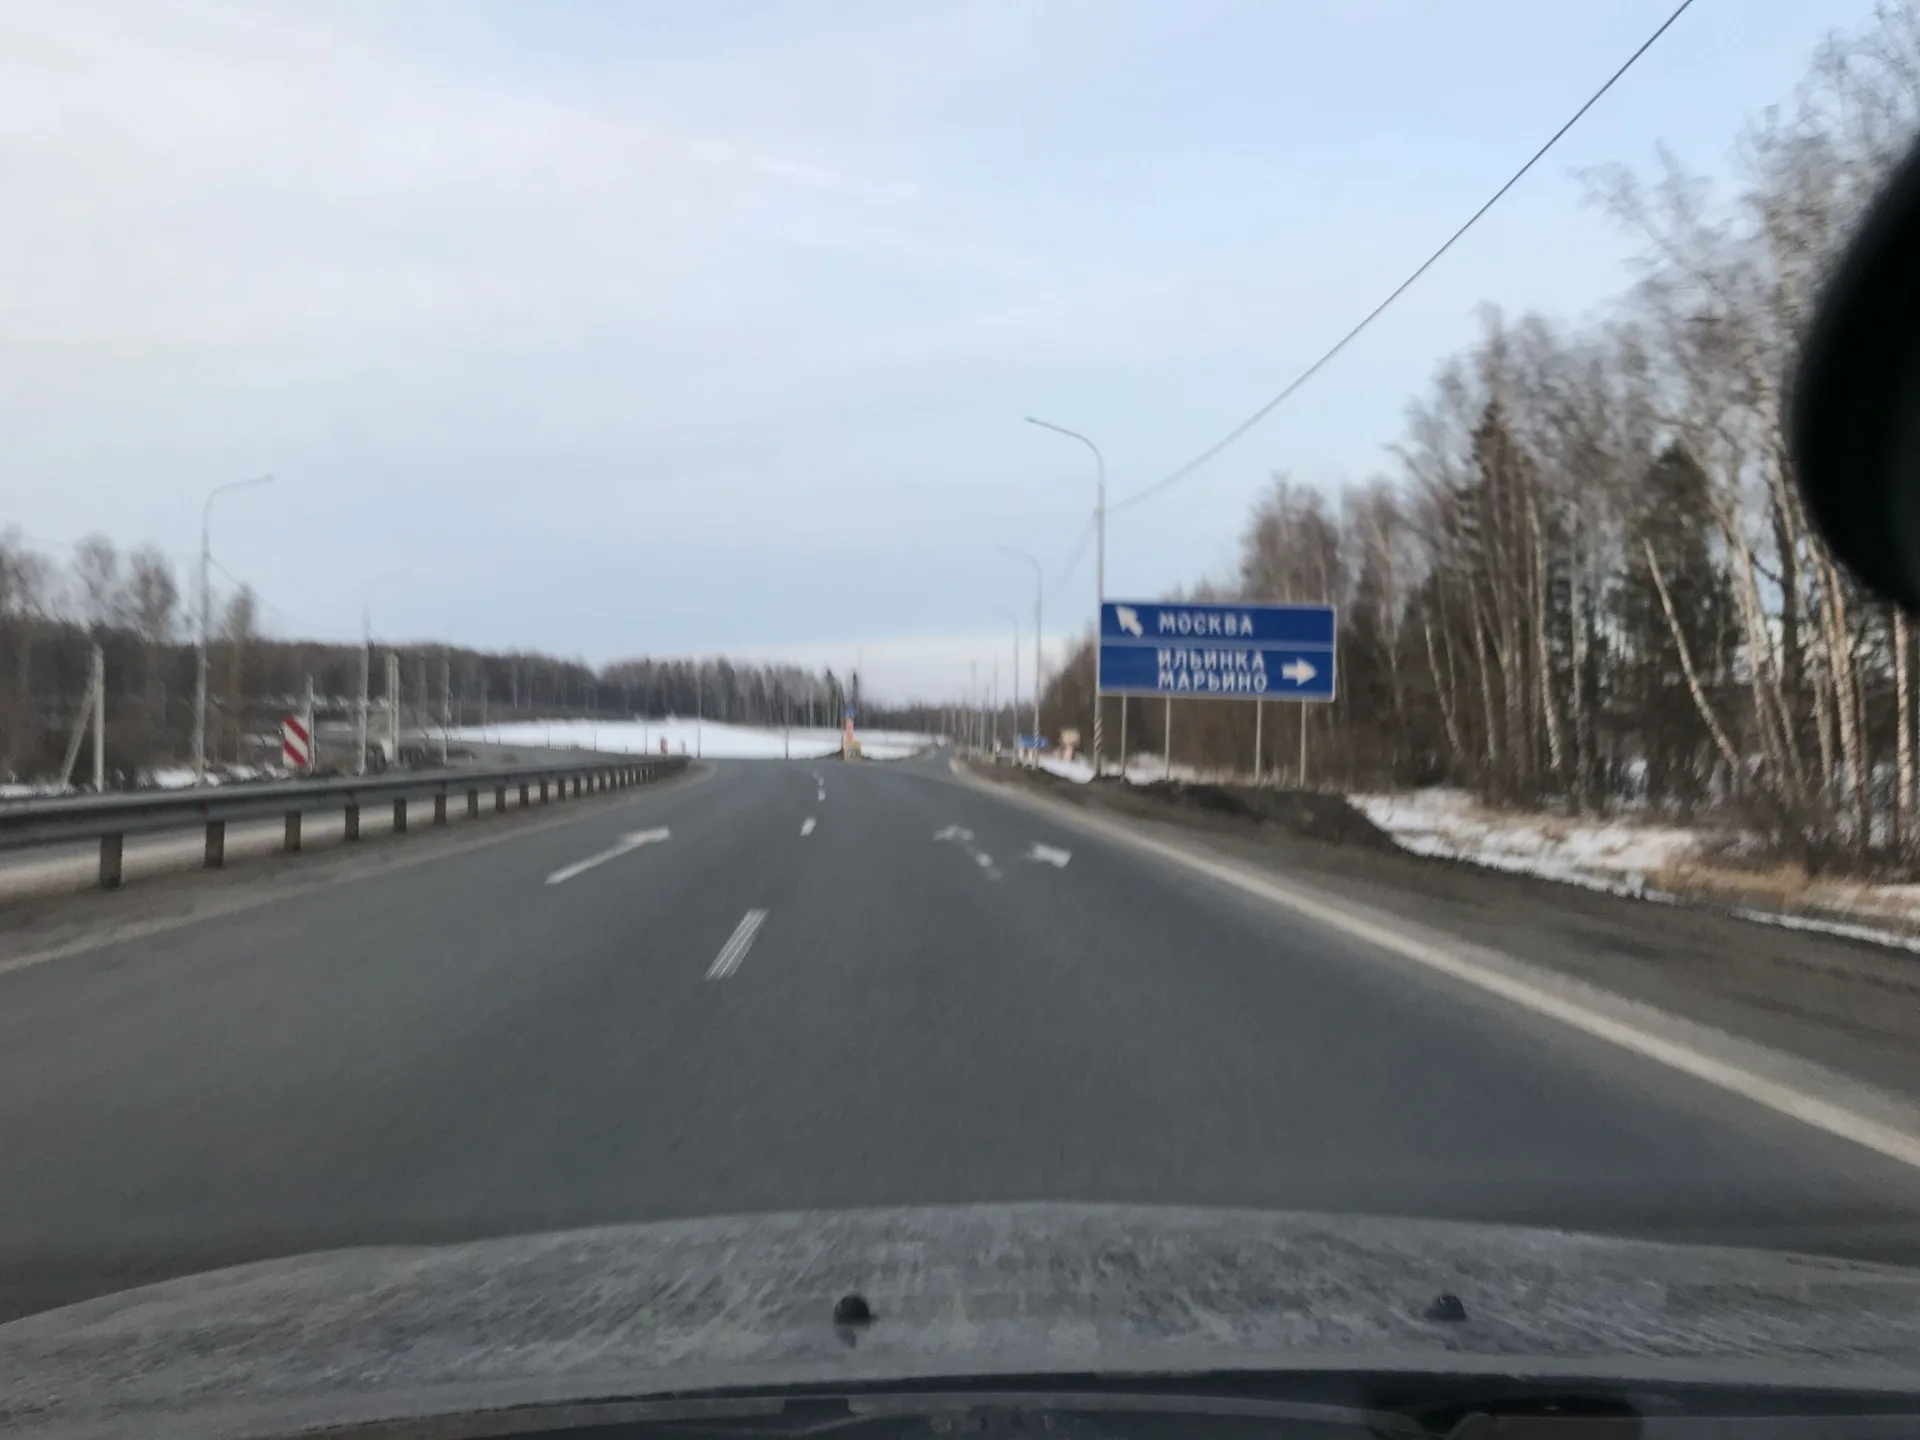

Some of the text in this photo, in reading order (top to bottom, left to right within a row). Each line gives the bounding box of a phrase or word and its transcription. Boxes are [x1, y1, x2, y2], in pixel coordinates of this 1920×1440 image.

[1158, 611, 1253, 636] МОСКВА
[1157, 649, 1265, 671] ИЛЬИНКА
[1158, 671, 1268, 693] МАРЬИНО
